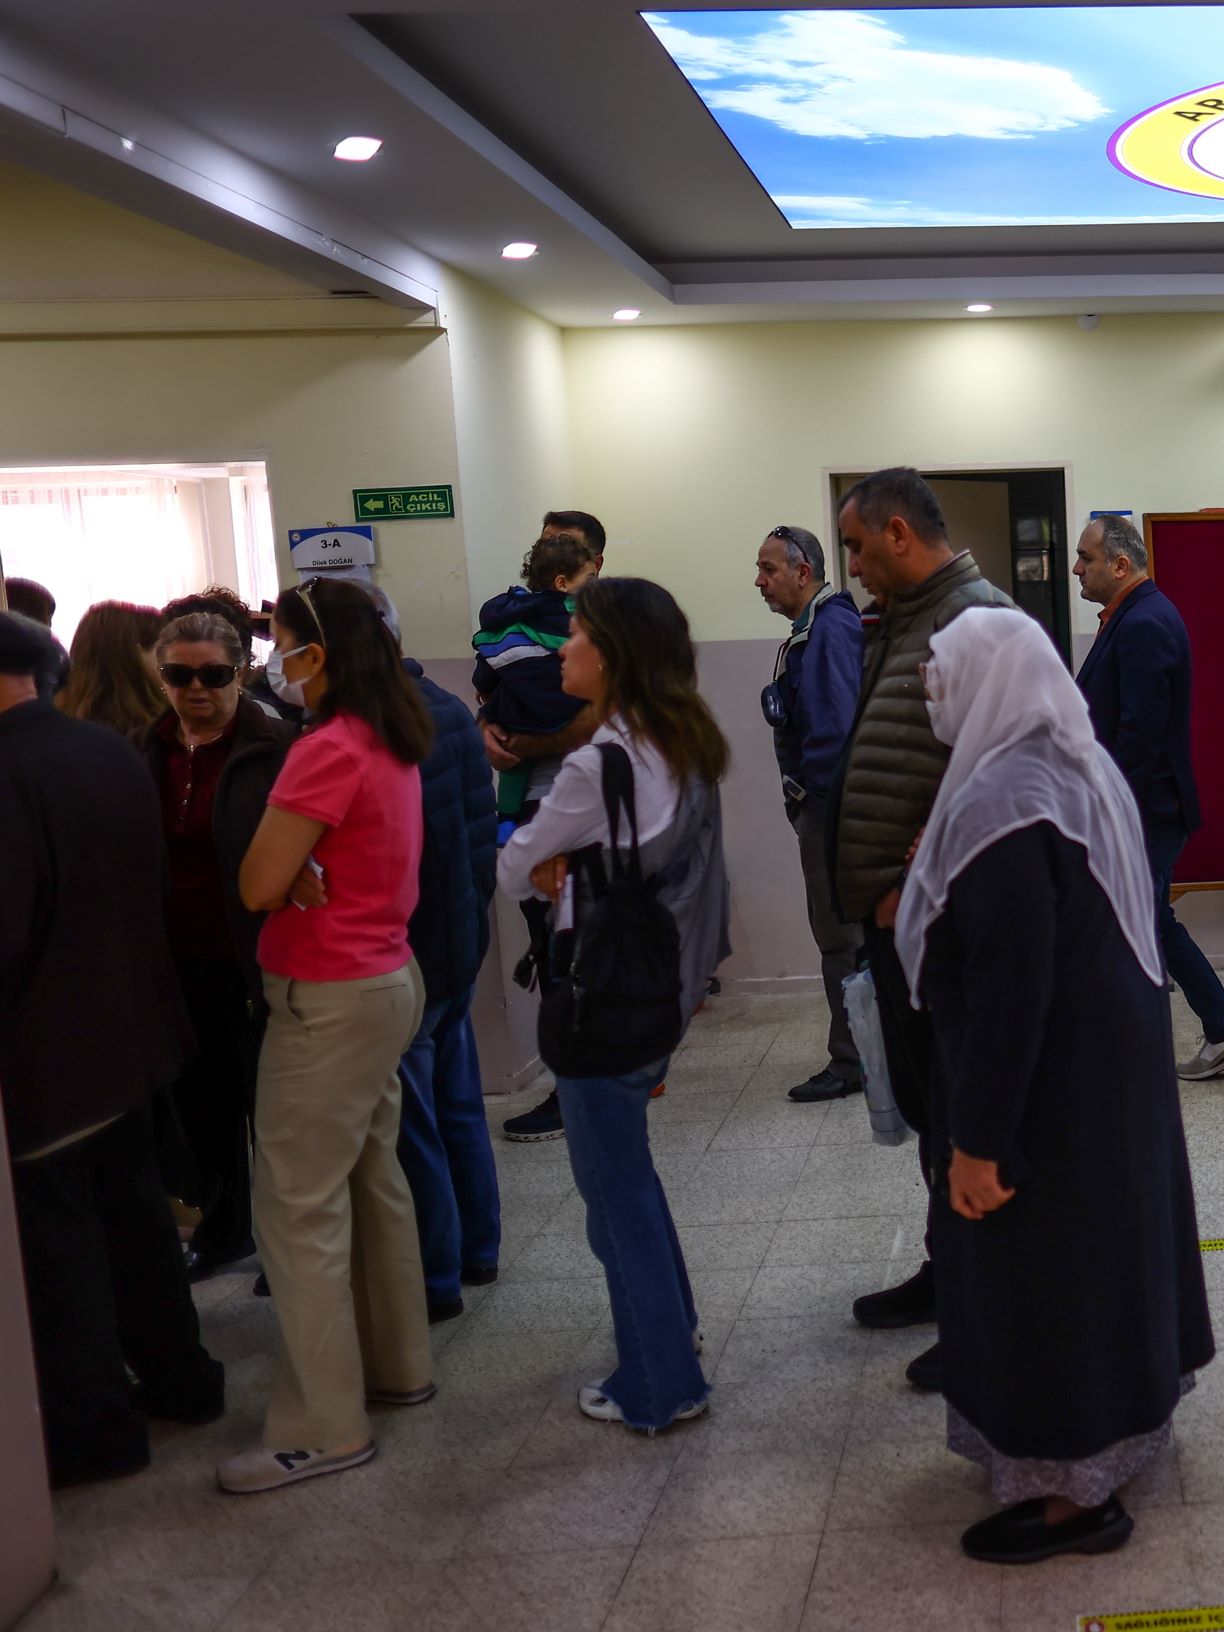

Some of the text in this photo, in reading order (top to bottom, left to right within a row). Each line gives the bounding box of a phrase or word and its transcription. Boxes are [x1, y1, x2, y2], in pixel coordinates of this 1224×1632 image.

[408, 492, 442, 502] ACİL
[406, 502, 446, 512] ÇIKIŞ
[320, 539, 342, 549] 3-A
[328, 557, 353, 566] DOĞAN
